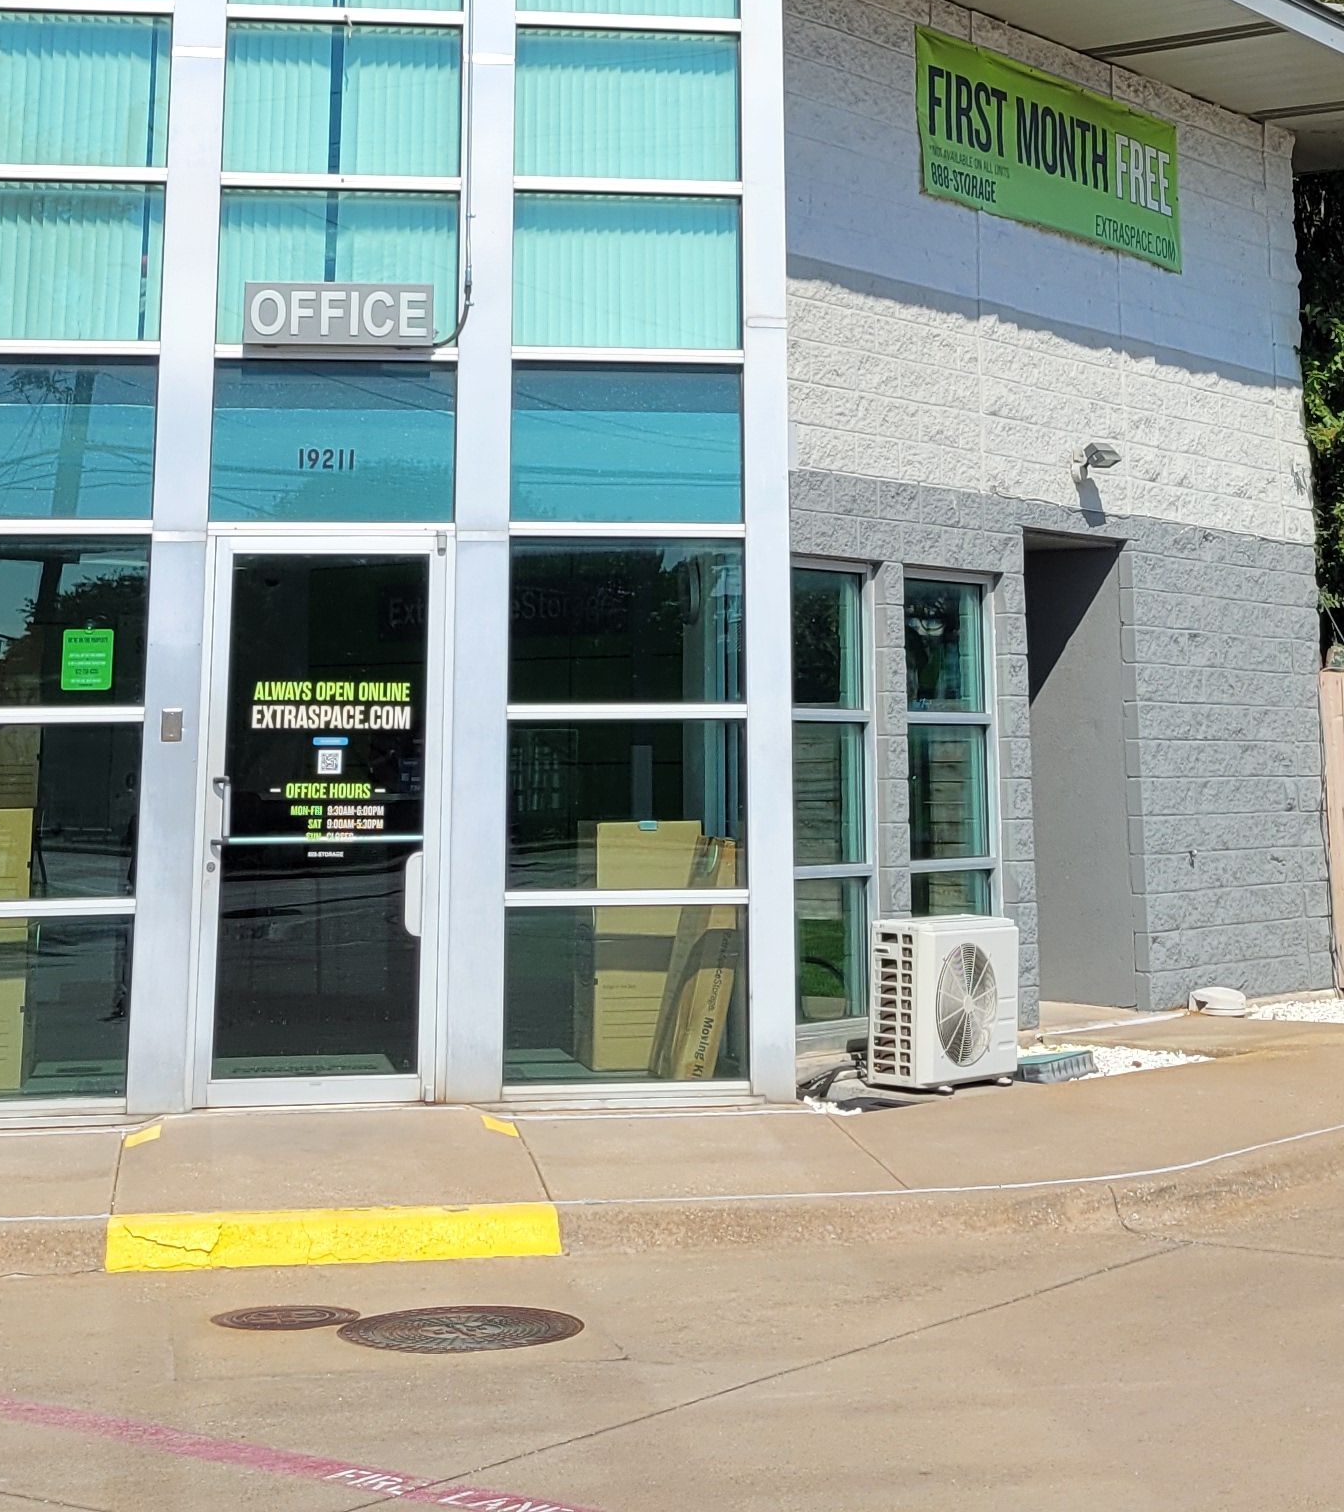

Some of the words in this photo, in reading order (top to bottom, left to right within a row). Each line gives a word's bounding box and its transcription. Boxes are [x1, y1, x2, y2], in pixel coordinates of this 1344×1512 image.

[927, 64, 1008, 159] FIRST
[1016, 95, 1109, 193] MONTH
[1115, 132, 1173, 218] FREE
[943, 149, 973, 168] AVAILABLE
[974, 158, 983, 170] ON
[930, 161, 997, 204] 888-STORAGE
[1095, 214, 1177, 262] EXTRASPACE.COM
[250, 289, 429, 337] OFFICE
[298, 448, 355, 470] 19211
[254, 681, 312, 701] ALWAYS
[316, 681, 355, 701] OPEN
[358, 682, 411, 701] ONLINE
[251, 704, 411, 730] EXTRASPACE.COM
[286, 783, 327, 799] OFFICE
[329, 783, 371, 799] HOURS
[290, 805, 323, 816] MON-FRI
[308, 819, 322, 829] SAT
[694, 1016, 715, 1062] Moving
